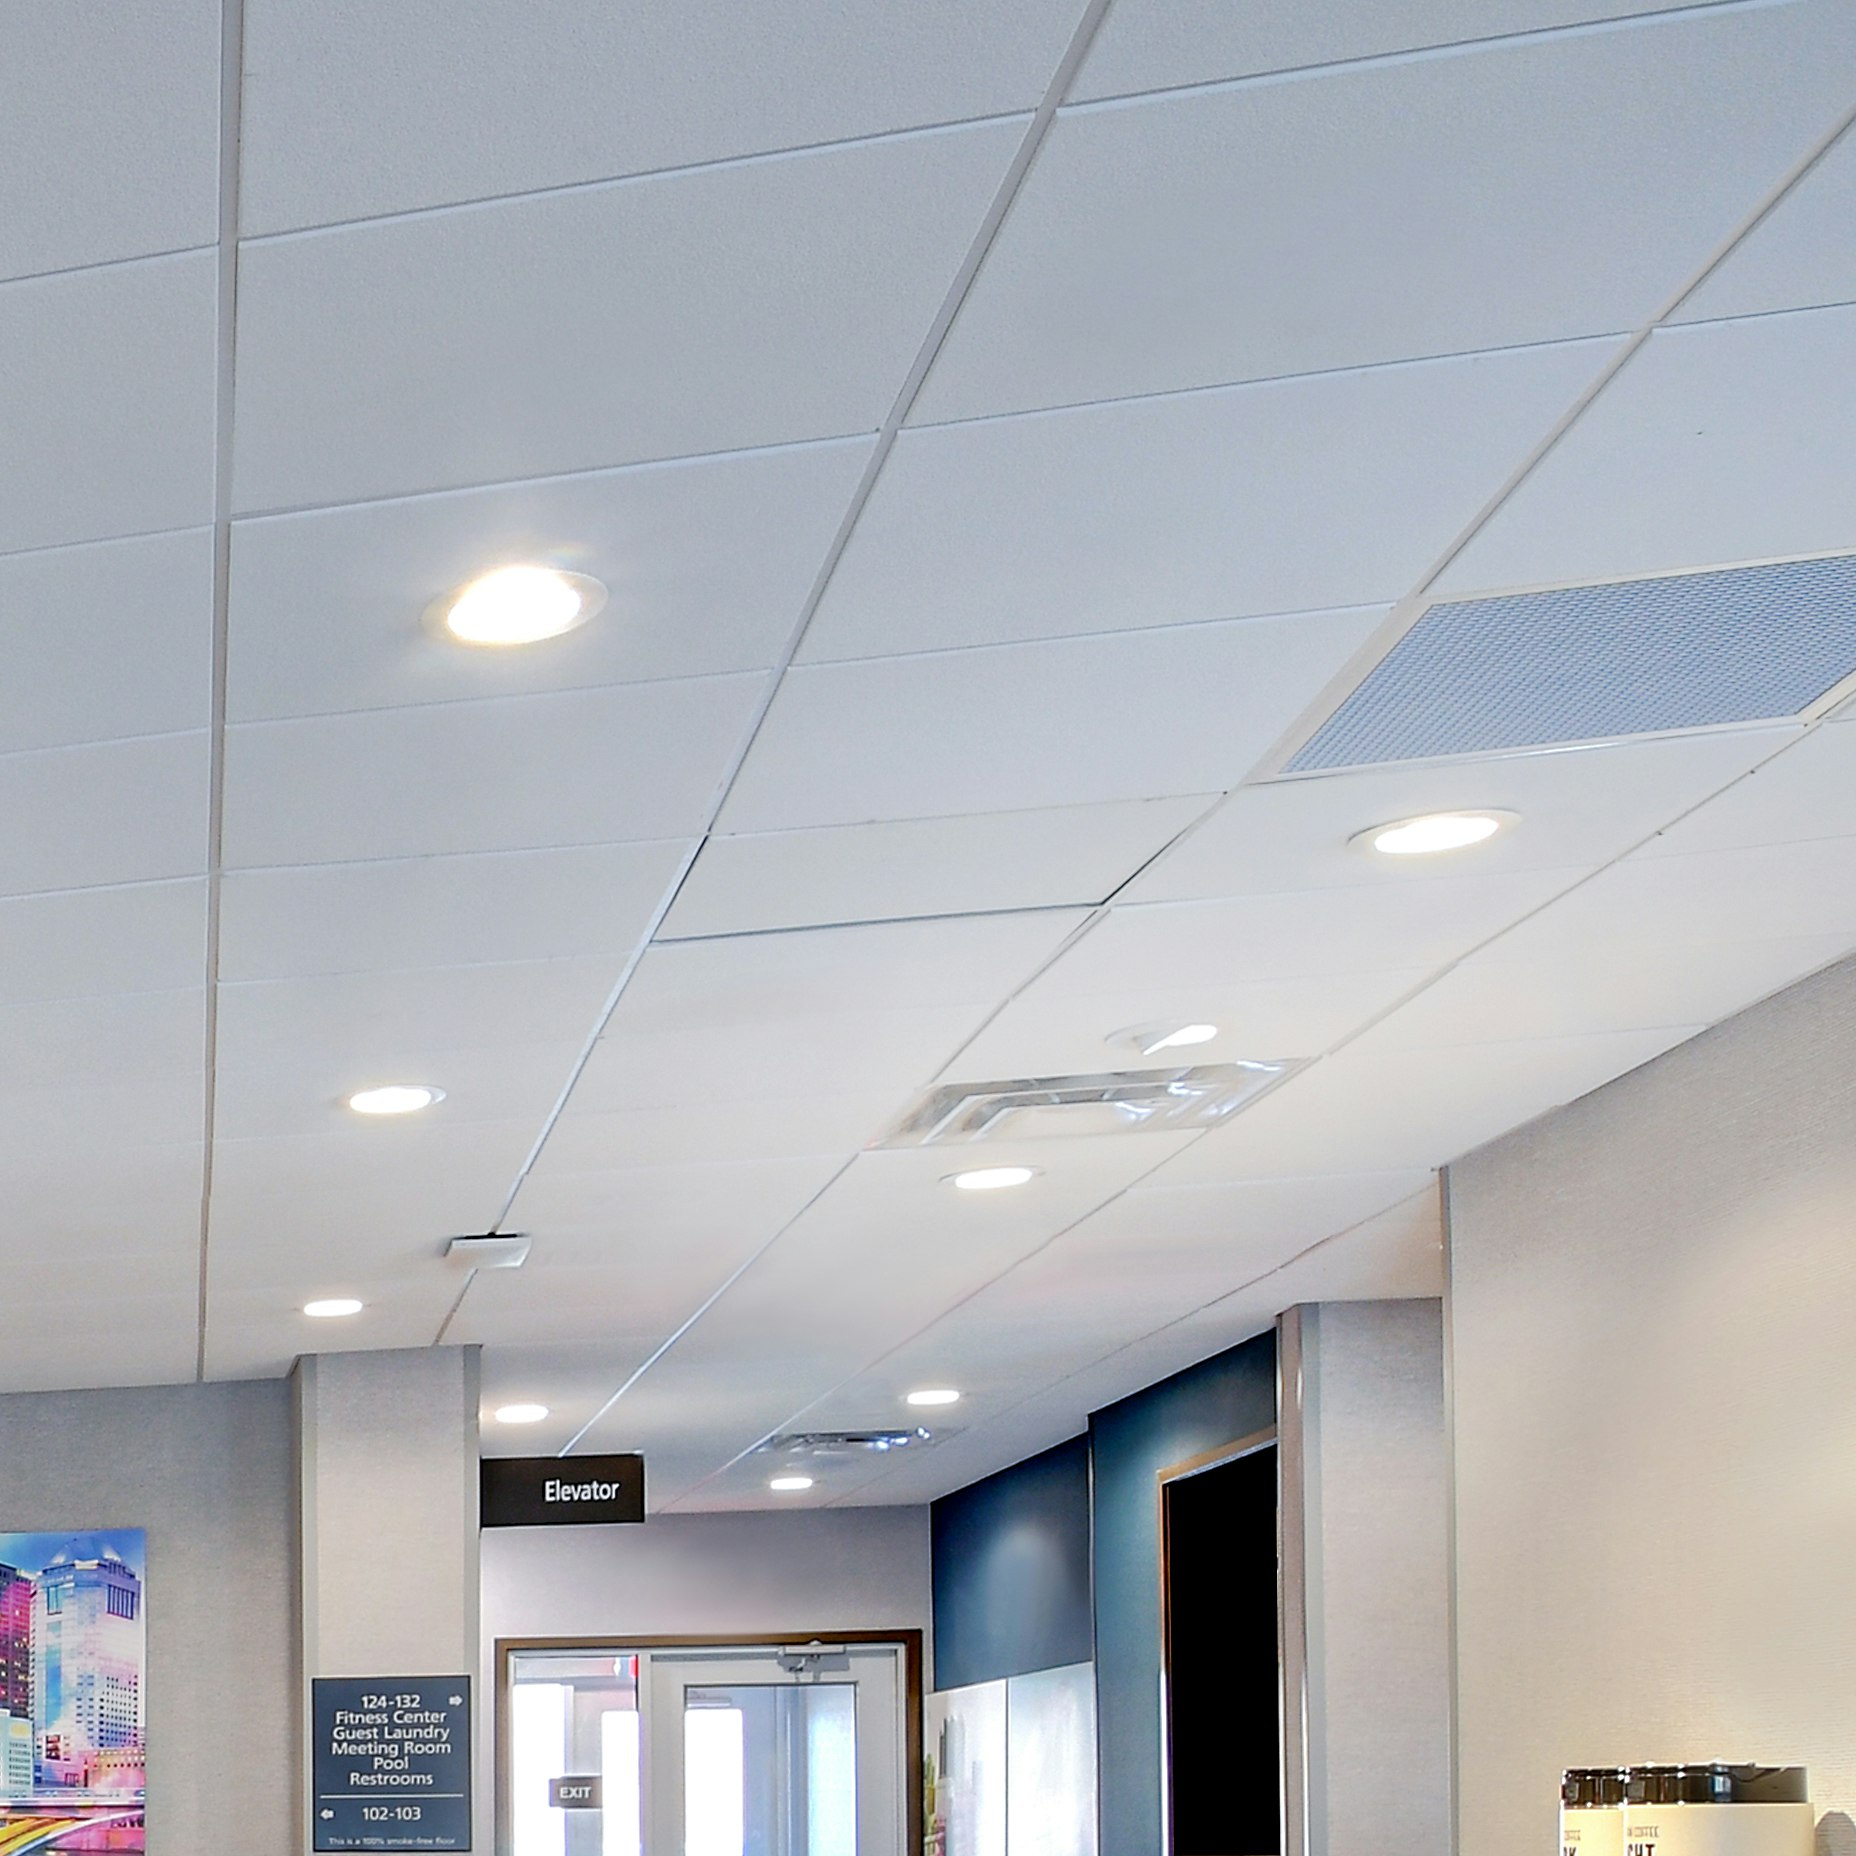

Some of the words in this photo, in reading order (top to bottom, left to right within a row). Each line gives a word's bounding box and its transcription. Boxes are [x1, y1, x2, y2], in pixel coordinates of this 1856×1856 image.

[544, 1479, 619, 1503] Elevator
[361, 1694, 421, 1709] 124-132
[335, 1711, 389, 1725] Fitness
[393, 1710, 447, 1724] Center
[332, 1727, 379, 1740] Guest
[384, 1724, 450, 1742] Laundry
[331, 1742, 399, 1758] Meeting
[404, 1741, 451, 1754] Room
[373, 1756, 409, 1770] Pool
[349, 1772, 434, 1786] Restrooms
[559, 1785, 592, 1799] EXIT
[362, 1806, 422, 1821] 102-103
